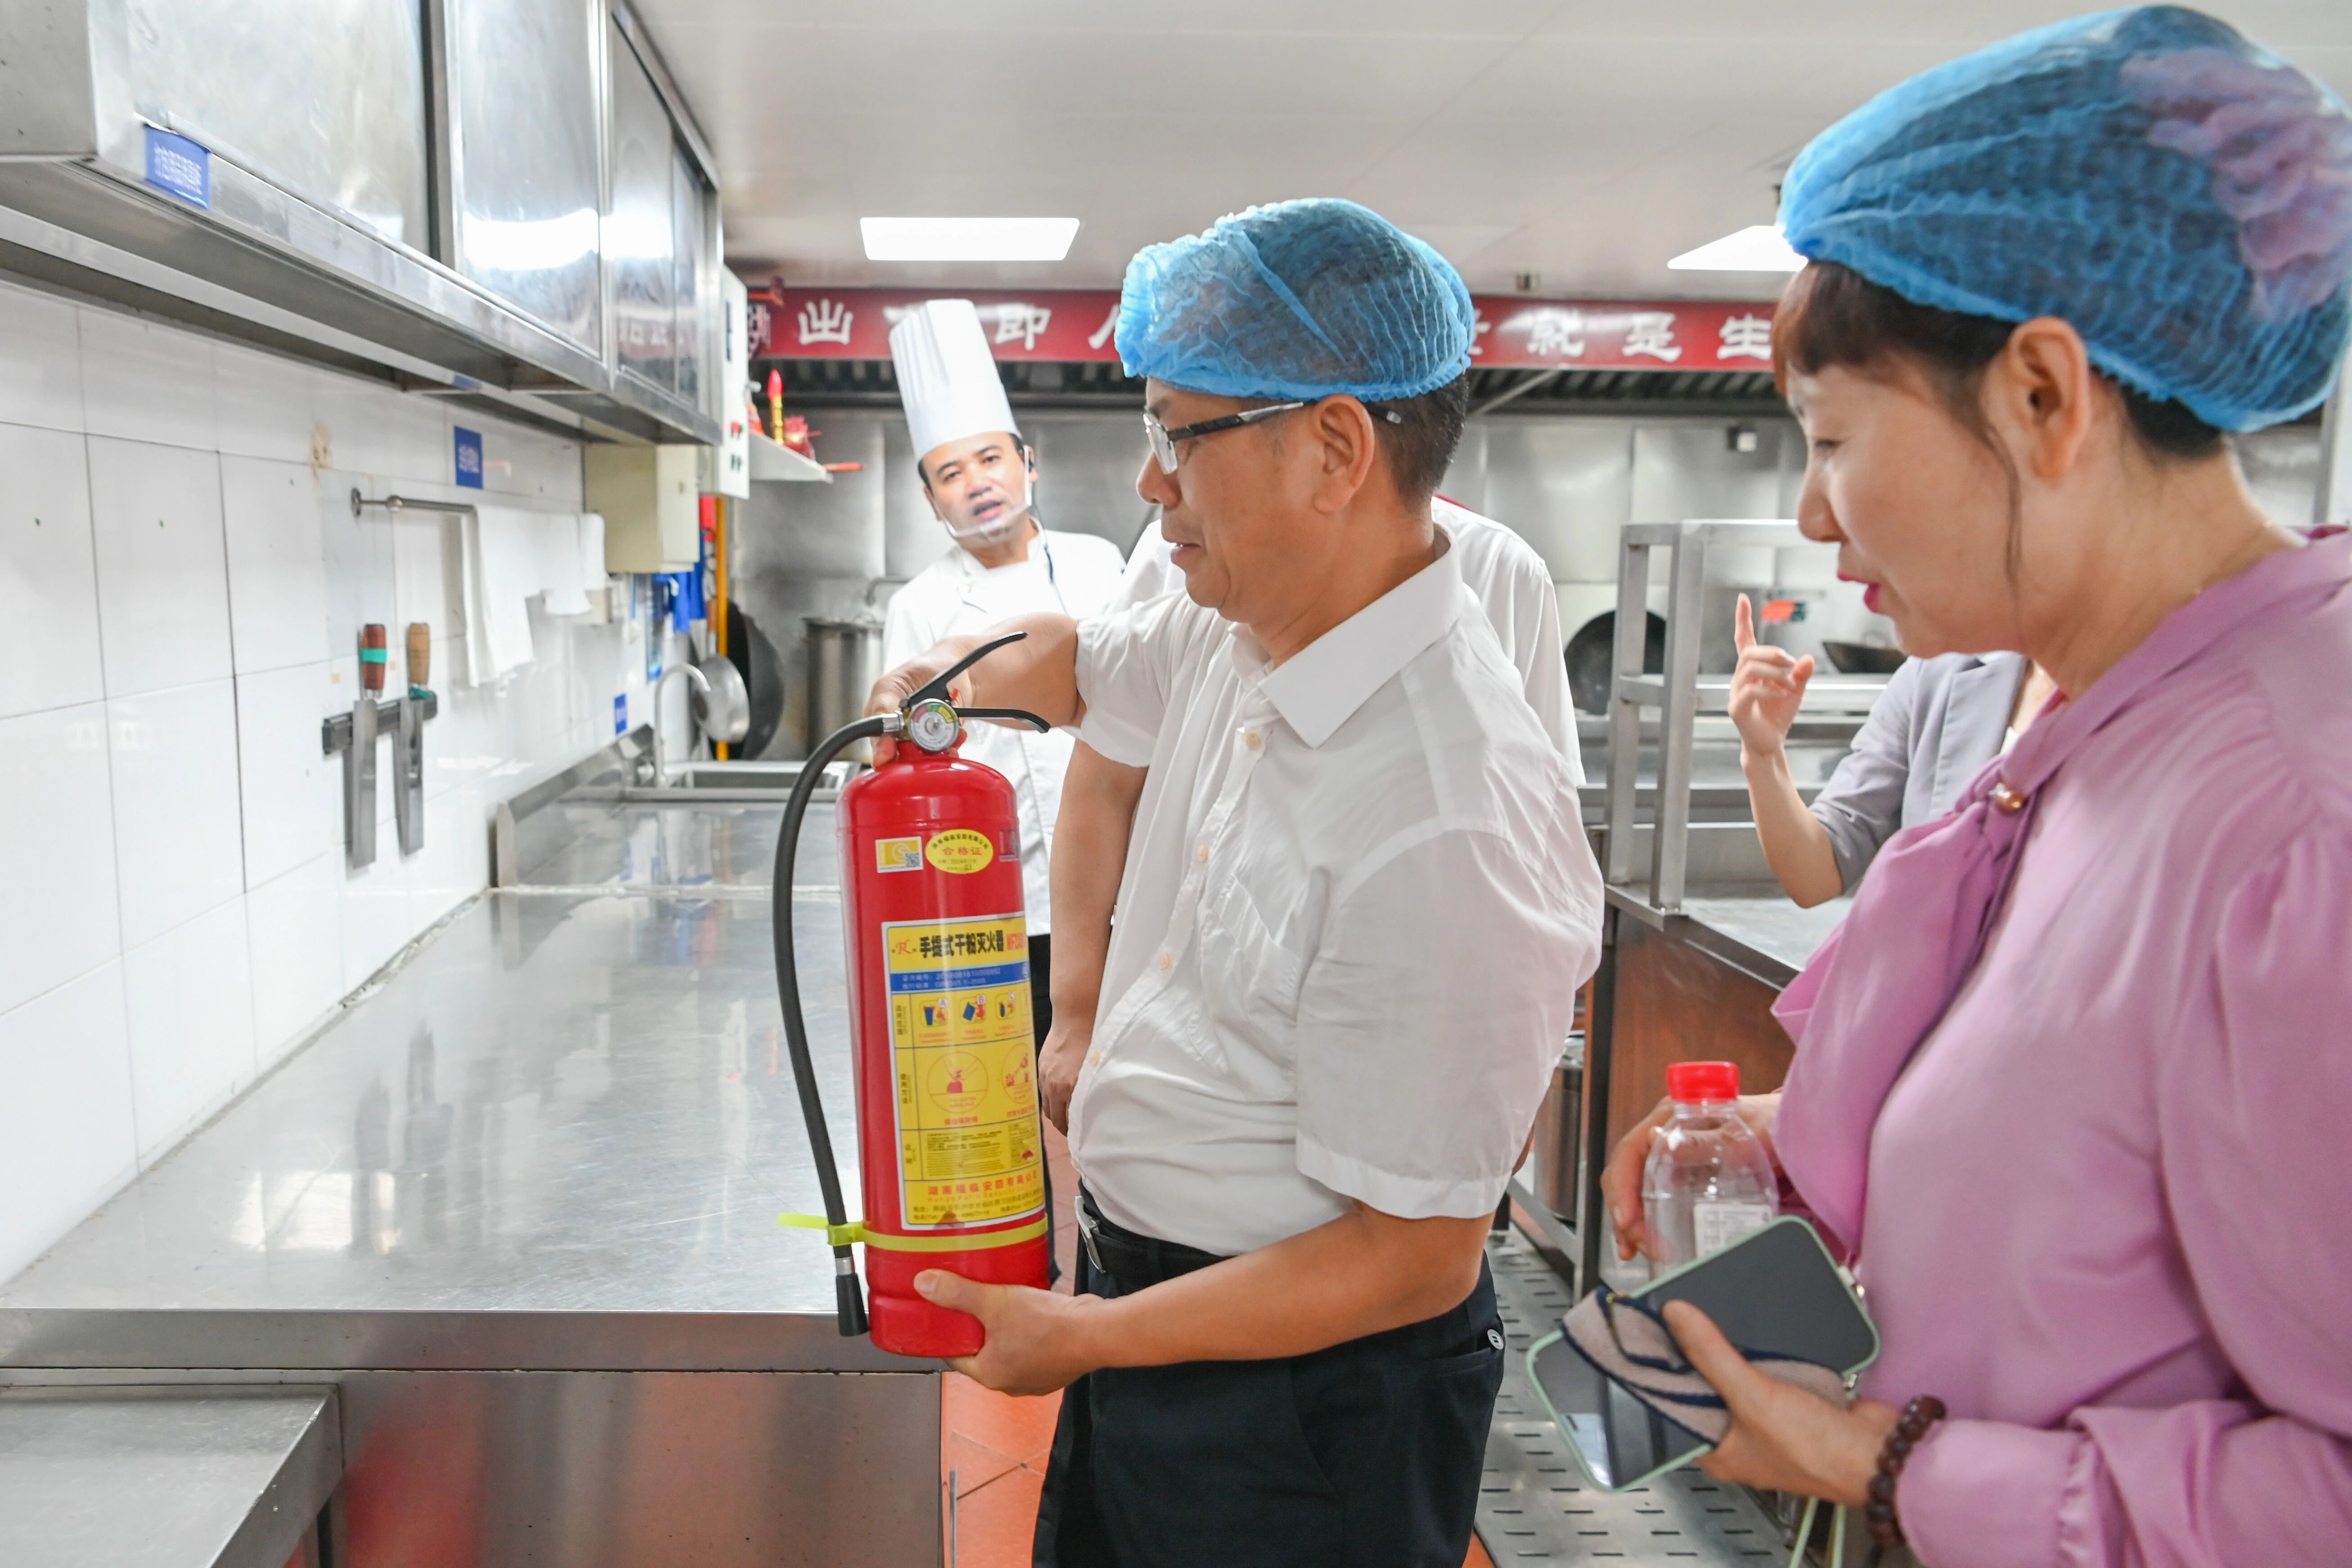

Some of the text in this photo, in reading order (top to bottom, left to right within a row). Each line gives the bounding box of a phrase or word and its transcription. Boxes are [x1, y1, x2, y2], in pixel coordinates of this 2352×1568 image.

[942, 847, 982, 856] 合格证
[920, 930, 1004, 958] 手提式干粉灭火器
